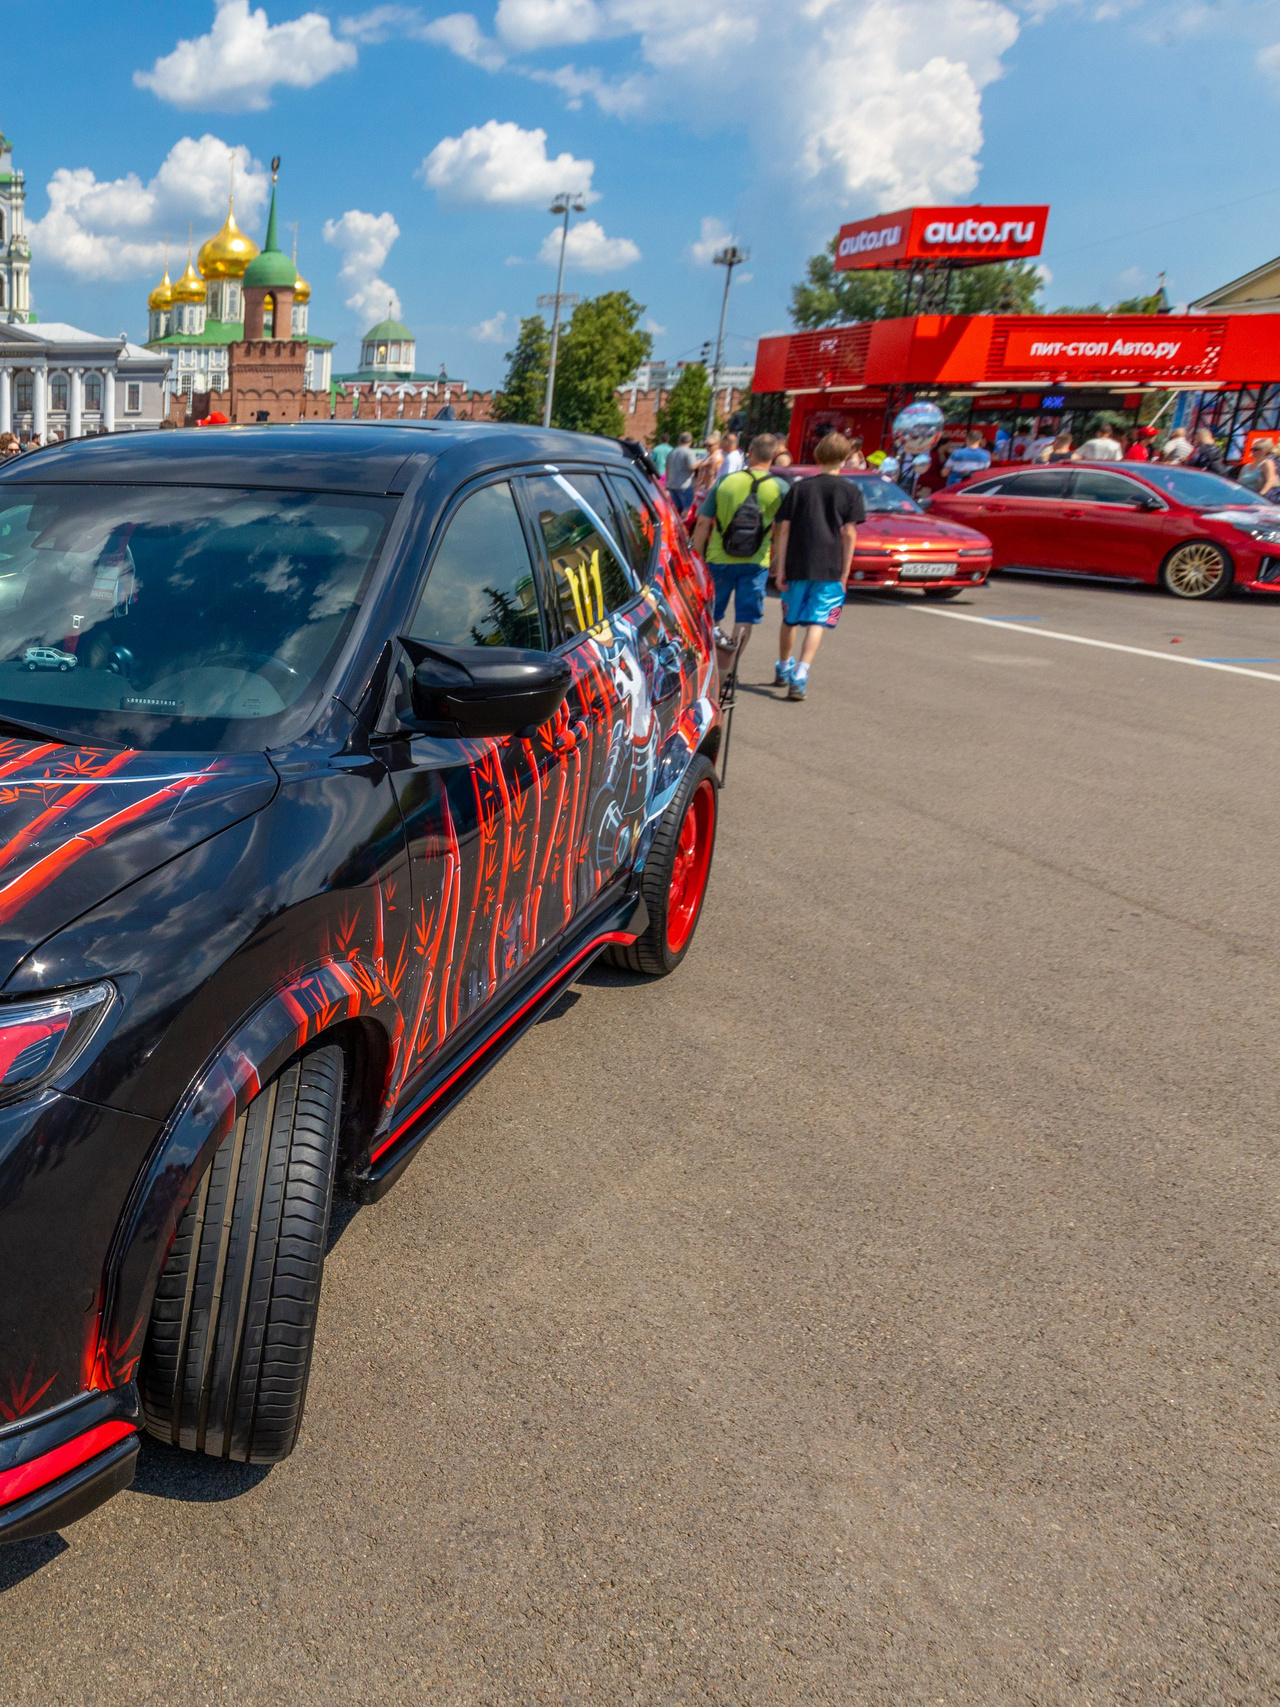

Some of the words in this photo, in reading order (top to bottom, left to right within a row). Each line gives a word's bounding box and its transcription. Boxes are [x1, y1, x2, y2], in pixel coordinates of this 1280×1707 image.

[839, 225, 903, 257] auto.ru
[923, 218, 1035, 244] auto.ru
[1030, 341, 1109, 357] пит-стоп
[1109, 338, 1182, 360] Авто.ру
